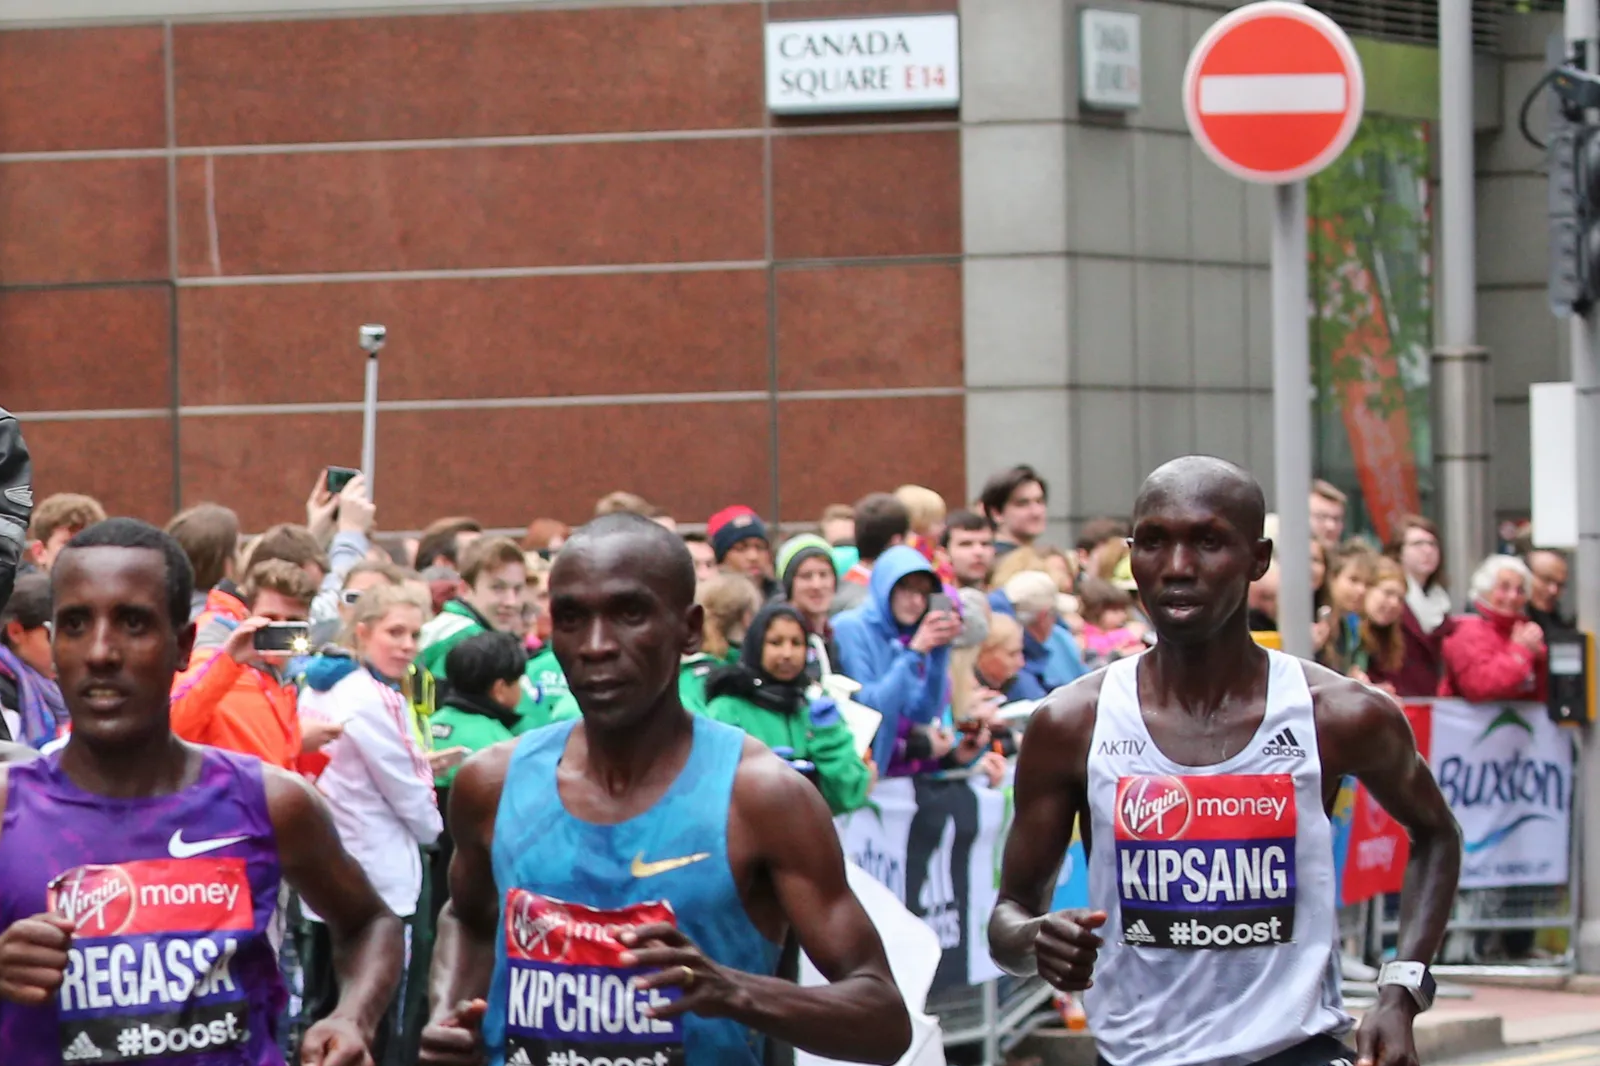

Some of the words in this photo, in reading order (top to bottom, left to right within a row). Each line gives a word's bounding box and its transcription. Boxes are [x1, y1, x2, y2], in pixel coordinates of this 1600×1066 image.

[779, 31, 910, 60] CANADA
[780, 66, 892, 97] SQUARE
[904, 65, 946, 90] E14
[1097, 740, 1147, 756] AKTIV
[1262, 744, 1306, 758] adidas
[1439, 748, 1564, 813] Buxton
[1124, 779, 1185, 834] Virgin
[1197, 797, 1287, 821] money
[1120, 846, 1288, 903] KIPSANG
[57, 868, 128, 930] Virgin
[140, 882, 240, 911] money
[1169, 916, 1282, 946] #boost
[60, 937, 238, 1011] REGASSA
[117, 1012, 238, 1057] #boost
